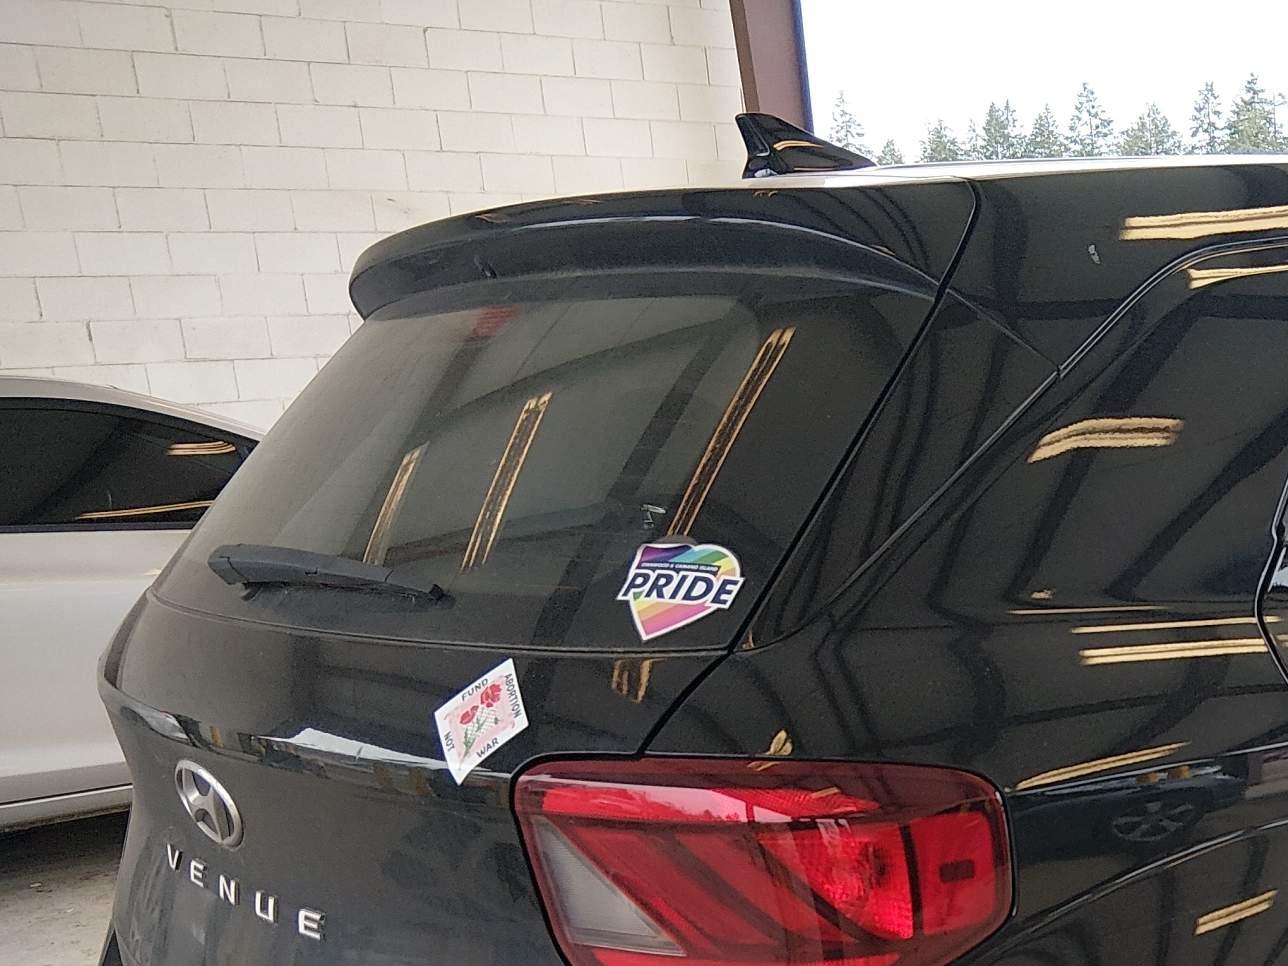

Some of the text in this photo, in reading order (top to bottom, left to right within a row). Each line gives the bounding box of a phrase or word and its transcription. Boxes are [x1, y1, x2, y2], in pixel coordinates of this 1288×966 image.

[622, 572, 740, 605] PRIDE
[461, 678, 488, 702] FUND
[504, 673, 522, 719] ABORTION
[443, 731, 455, 752] NOT
[476, 737, 500, 759] WAR
[166, 843, 327, 942] VENUE
